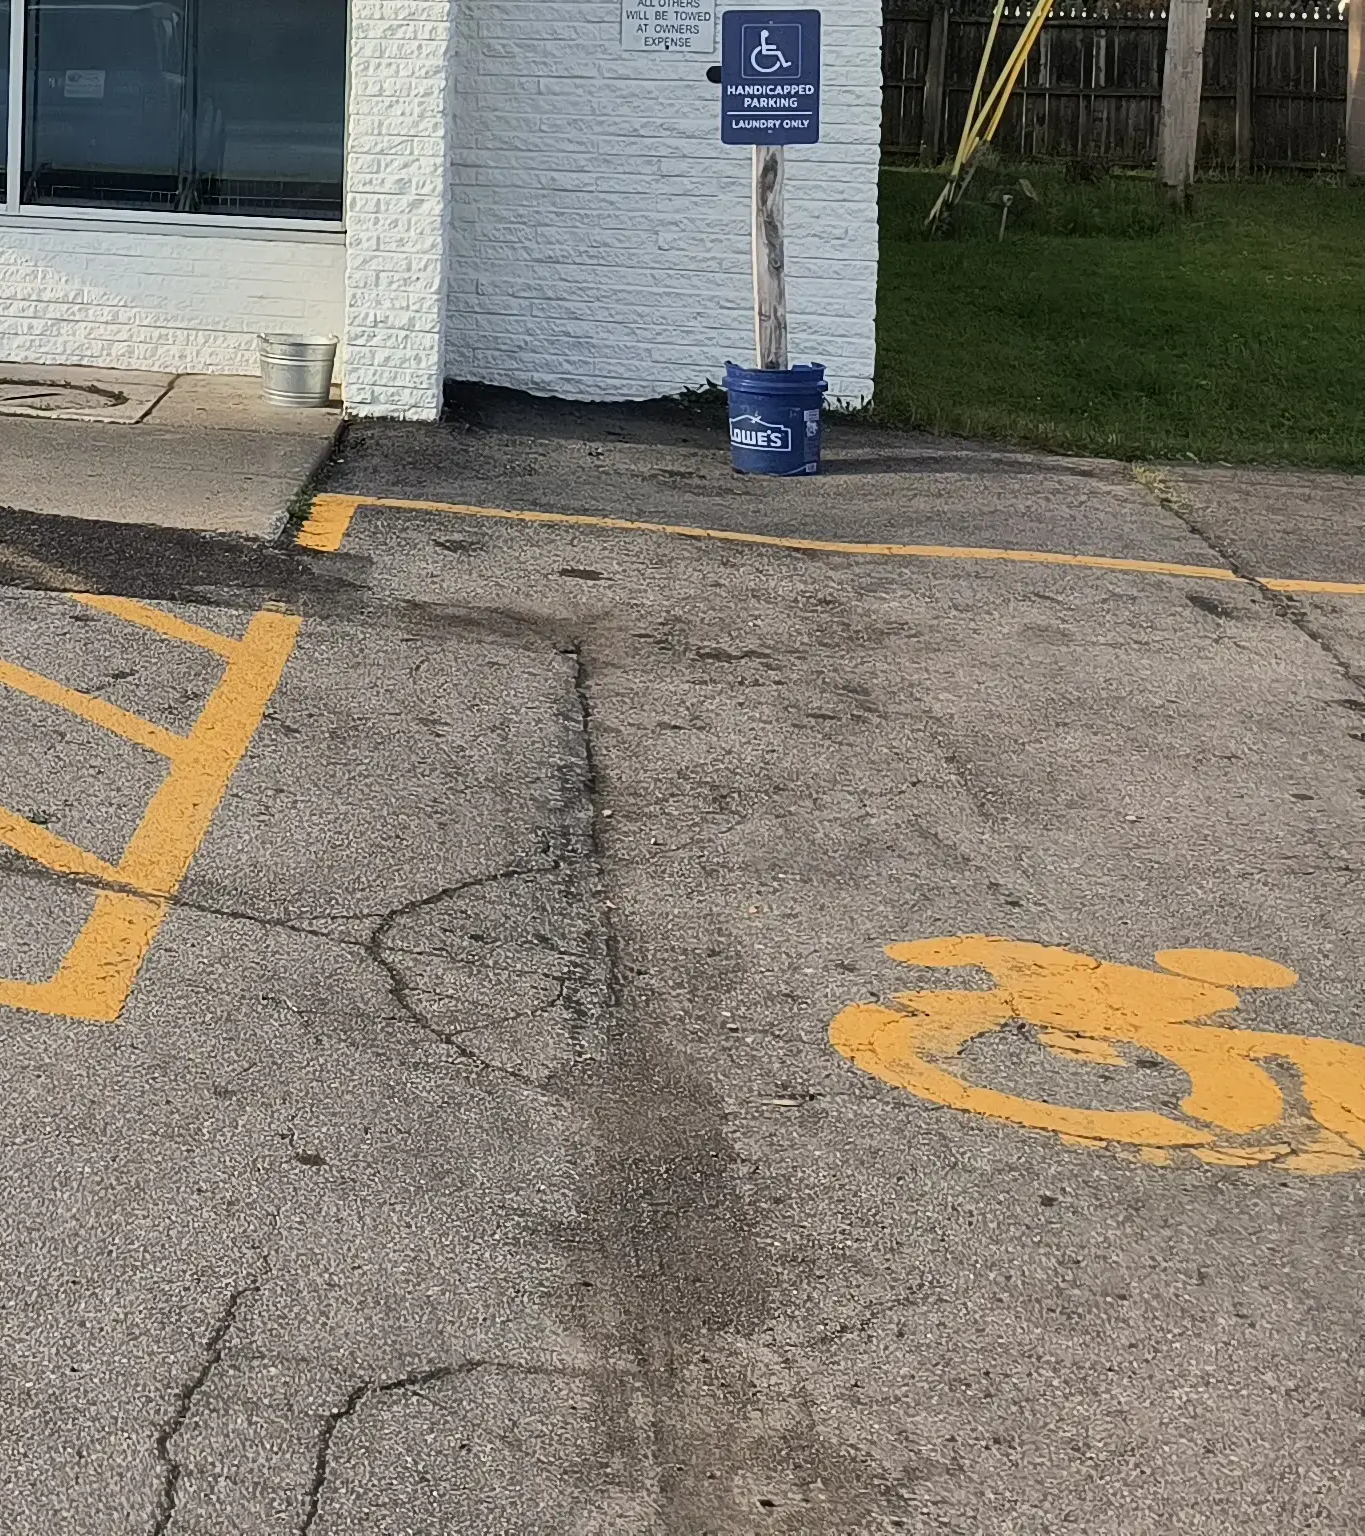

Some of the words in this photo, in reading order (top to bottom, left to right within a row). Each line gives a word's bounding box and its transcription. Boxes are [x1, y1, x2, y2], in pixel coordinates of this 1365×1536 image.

[625, 9, 650, 20] WILL
[655, 10, 669, 21] BE
[674, 10, 711, 22] TOWED
[636, 23, 649, 34] AT
[654, 24, 700, 34] OWNERS
[644, 36, 692, 48] EXPENSE
[727, 84, 815, 96] HANDICAPPED
[743, 97, 798, 108] PARKING
[731, 119, 781, 129] LAUNDRY
[782, 119, 810, 129] ONLY
